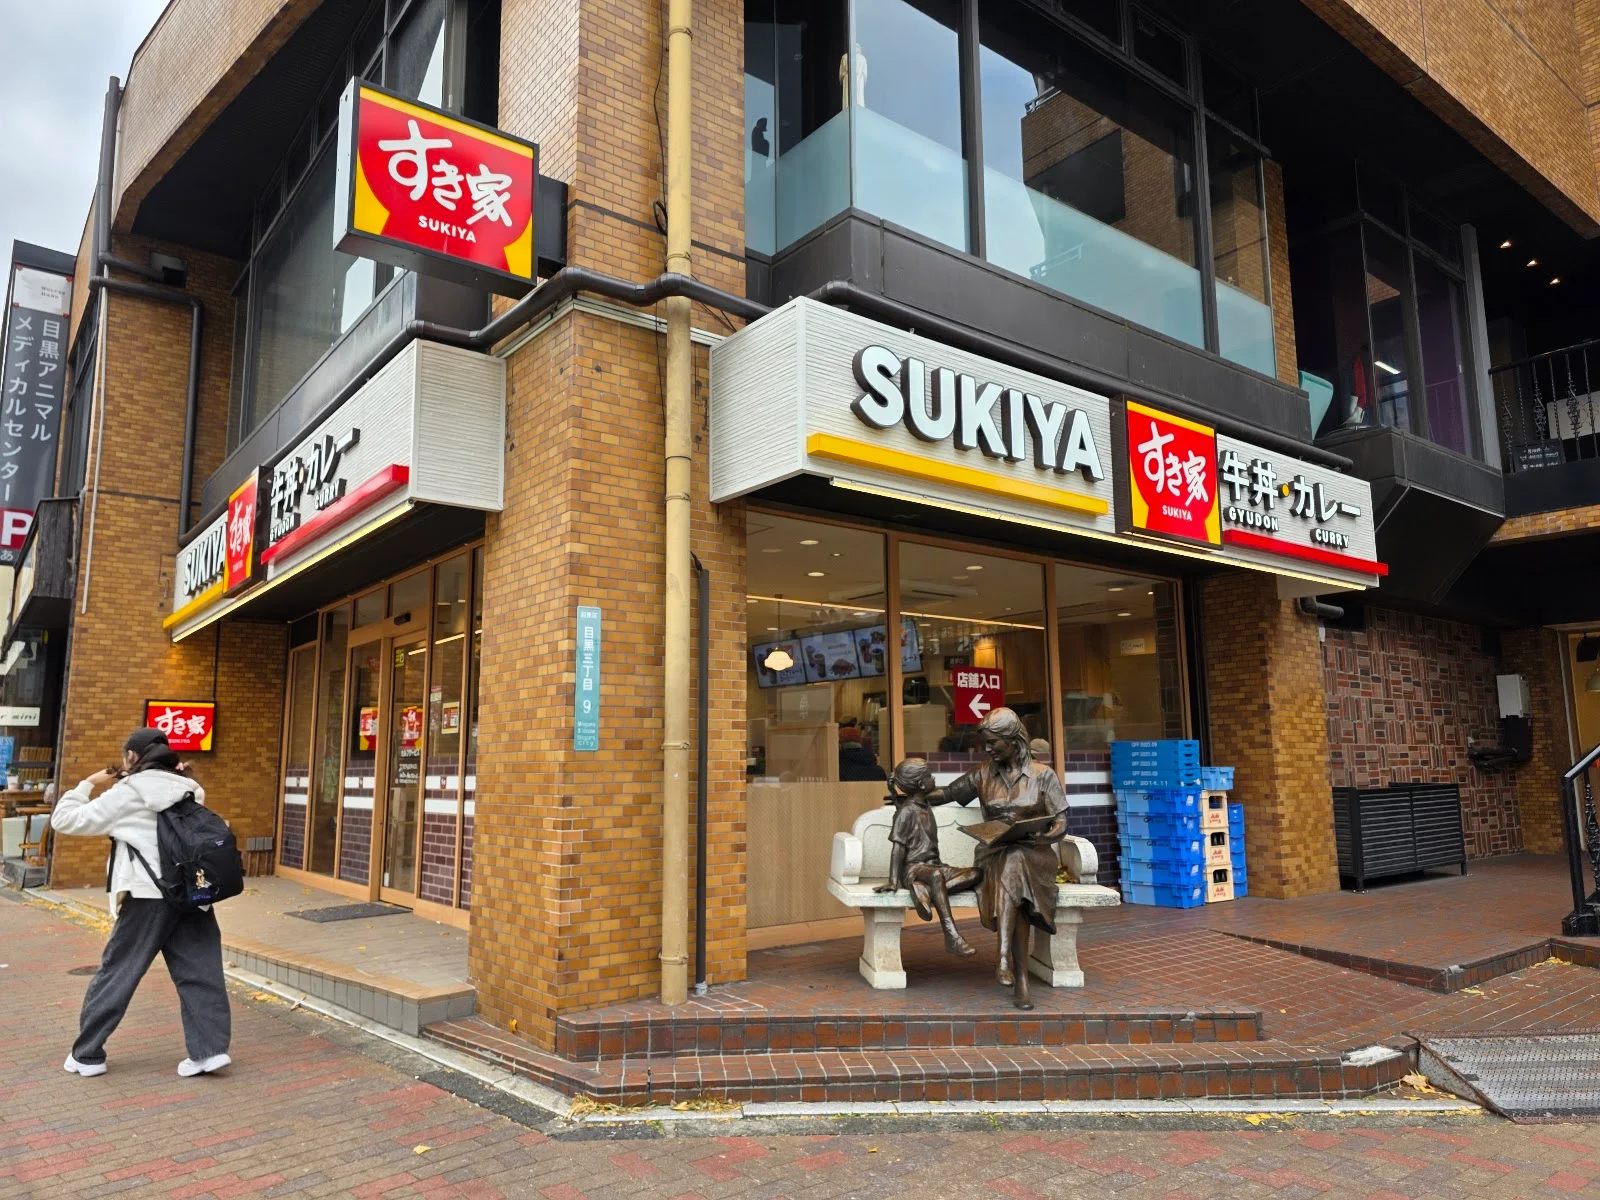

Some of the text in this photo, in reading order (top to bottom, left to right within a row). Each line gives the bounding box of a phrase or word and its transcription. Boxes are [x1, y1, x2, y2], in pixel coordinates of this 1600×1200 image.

[377, 119, 513, 227] すき家
[418, 215, 477, 243] SUKIYA
[31, 319, 60, 442] 目黒アニマル
[0, 315, 33, 500] メディカルセンター
[850, 344, 1105, 482] SUKIYA
[1138, 421, 1209, 507] すき家
[314, 478, 347, 511] CURRY
[1, 511, 34, 546] P
[229, 500, 253, 557] すき家
[269, 512, 301, 542] GYUDON
[1162, 504, 1193, 522] SUKIYA
[1224, 506, 1279, 532] GYUDON
[1311, 528, 1350, 549] CURRY
[183, 522, 227, 596] SUKIYA
[582, 626, 595, 691] 目黒三丁目
[957, 671, 1001, 690] 店舗入口
[154, 707, 206, 738] すき家
[582, 699, 592, 714] 9
